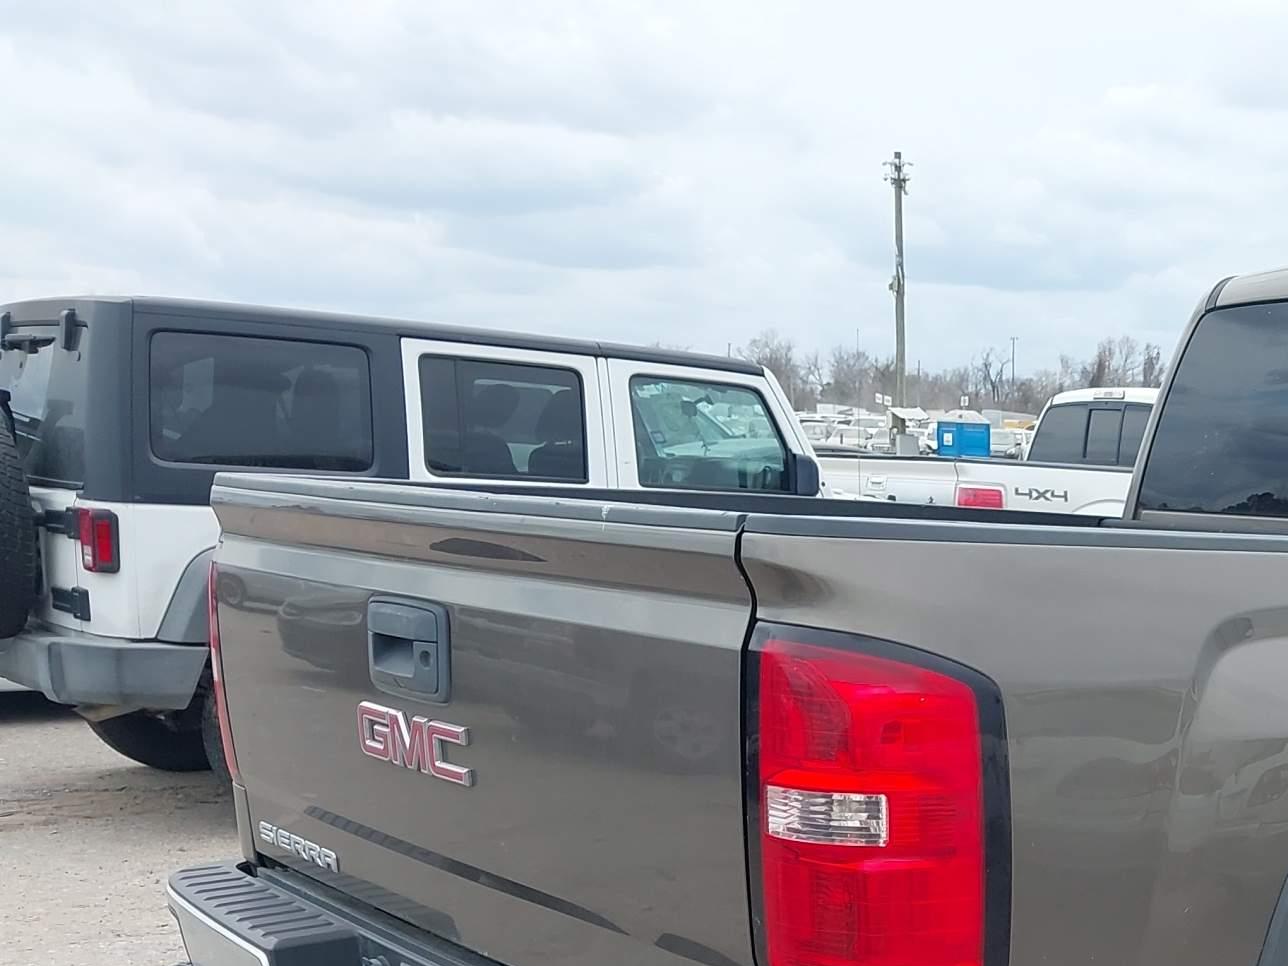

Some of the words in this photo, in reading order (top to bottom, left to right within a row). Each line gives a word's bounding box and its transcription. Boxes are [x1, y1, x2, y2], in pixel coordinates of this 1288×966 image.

[1014, 487, 1068, 502] 4X4
[357, 700, 473, 787] GMC
[259, 820, 339, 873] SIERRA
